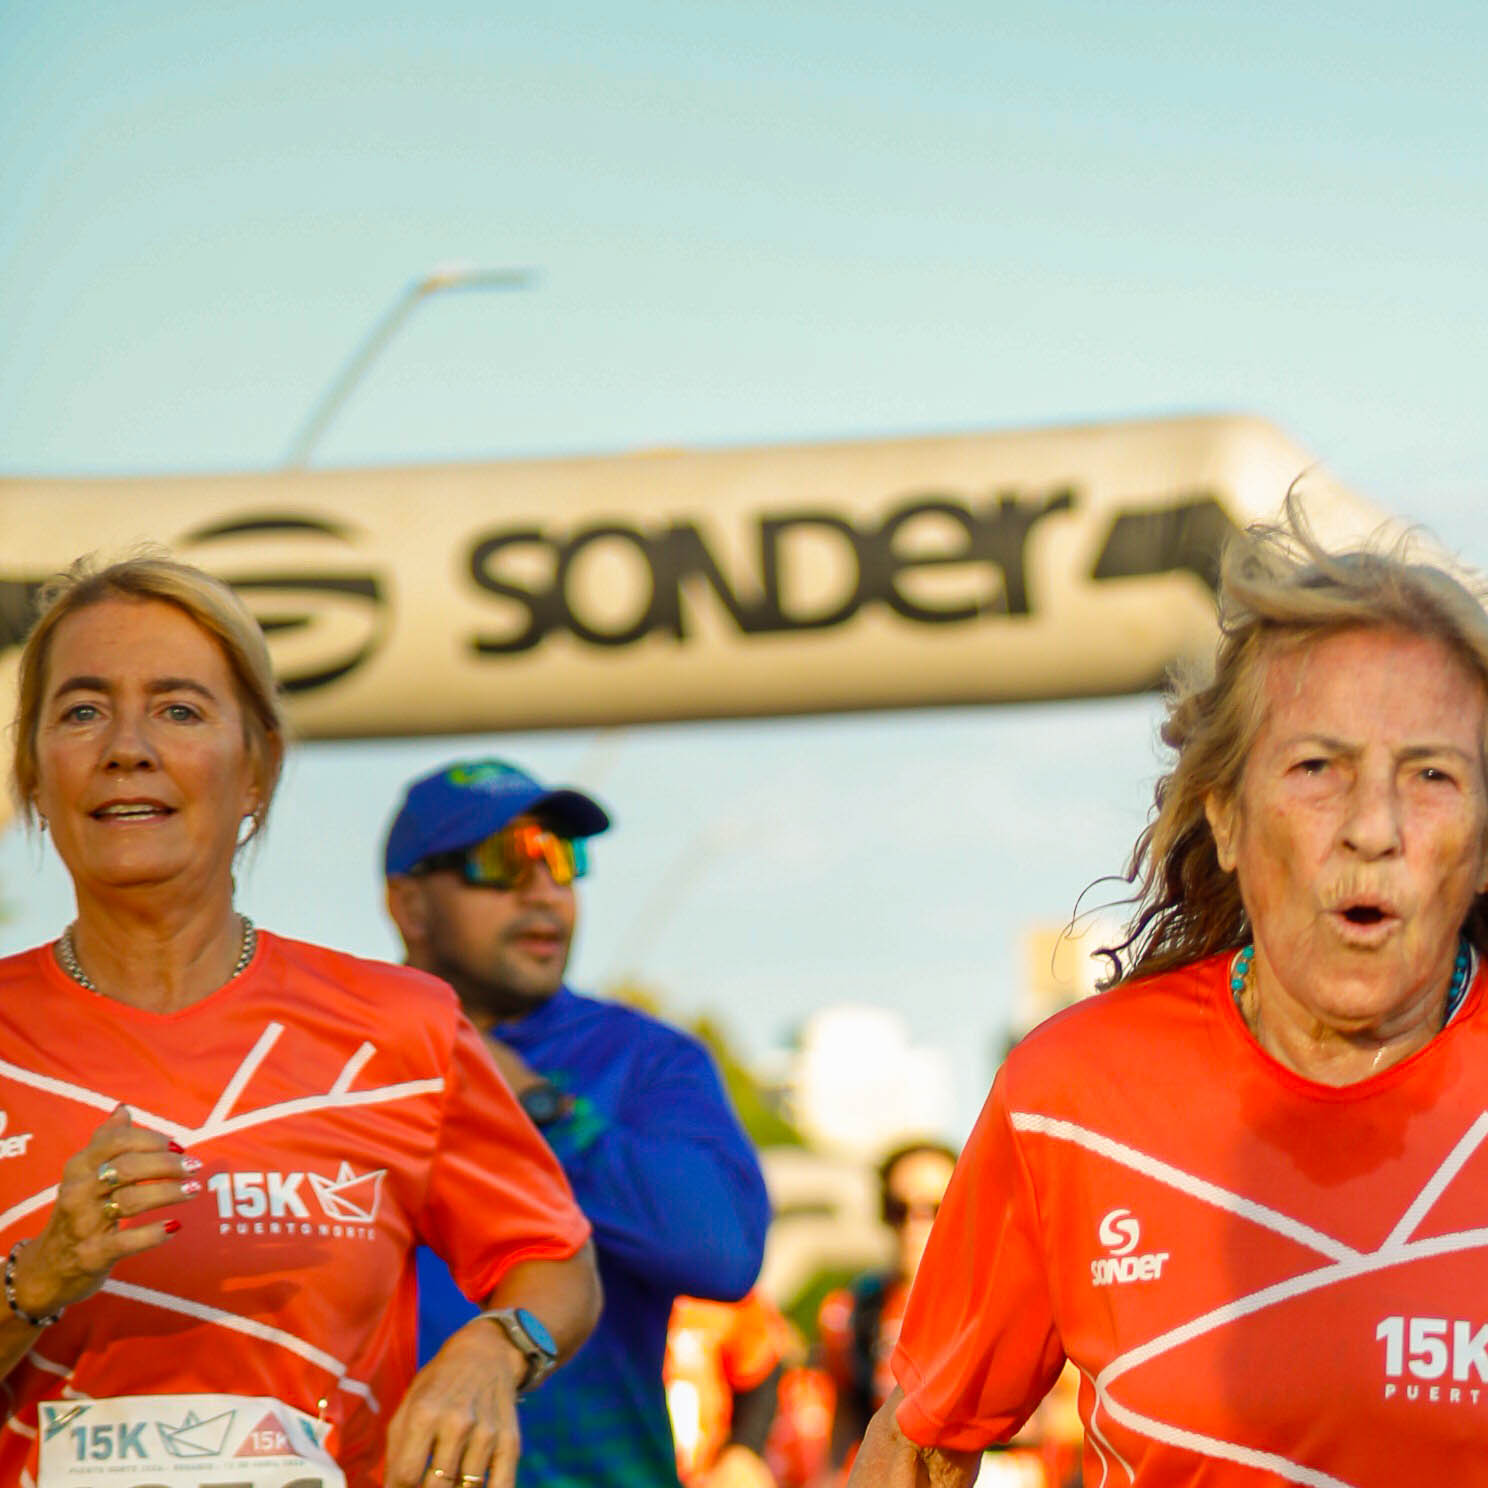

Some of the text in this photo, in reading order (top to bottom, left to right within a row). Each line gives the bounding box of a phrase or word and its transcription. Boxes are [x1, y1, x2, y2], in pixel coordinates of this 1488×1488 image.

[207, 1172, 310, 1218] 15K
[219, 1222, 313, 1235] PUERTO
[70, 1421, 149, 1462] 15K
